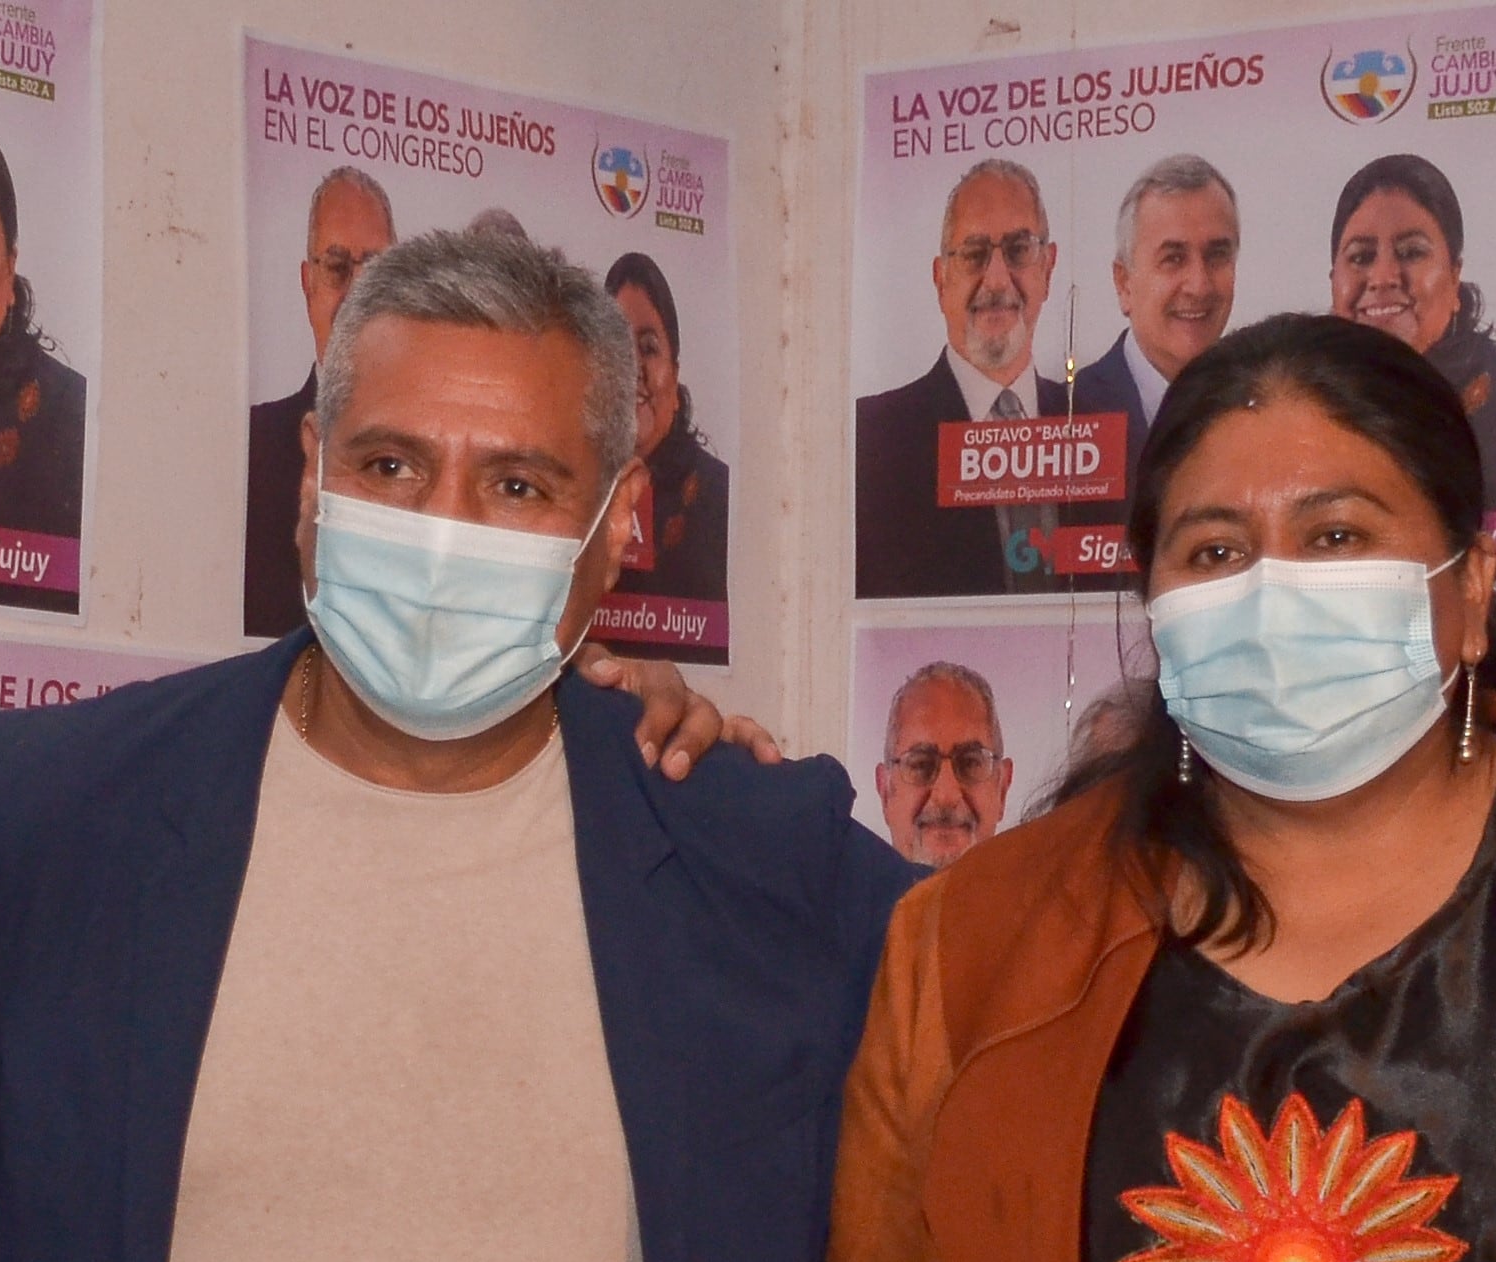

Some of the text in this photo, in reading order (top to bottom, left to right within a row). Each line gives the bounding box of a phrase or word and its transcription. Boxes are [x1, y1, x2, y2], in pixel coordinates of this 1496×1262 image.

[1435, 36, 1486, 52] Frente
[20, 78, 38, 95] 502
[41, 84, 51, 98] A
[891, 51, 1265, 124] LA VOZ DE LOS JUJEÑOS
[263, 67, 556, 157] LA VOZ DE LOS JUJEÑOS
[1466, 100, 1491, 115] 502
[264, 107, 484, 178] EN EL CONGRESO
[893, 101, 1156, 159] EN EL CONGRESO
[656, 186, 704, 215] JUJUY
[963, 426, 1033, 445] GUSTAVO
[960, 441, 1101, 481] BOUHID
[953, 486, 1016, 502] Precandidato
[1017, 484, 1064, 502] Diputado
[661, 604, 708, 642] Jujuy
